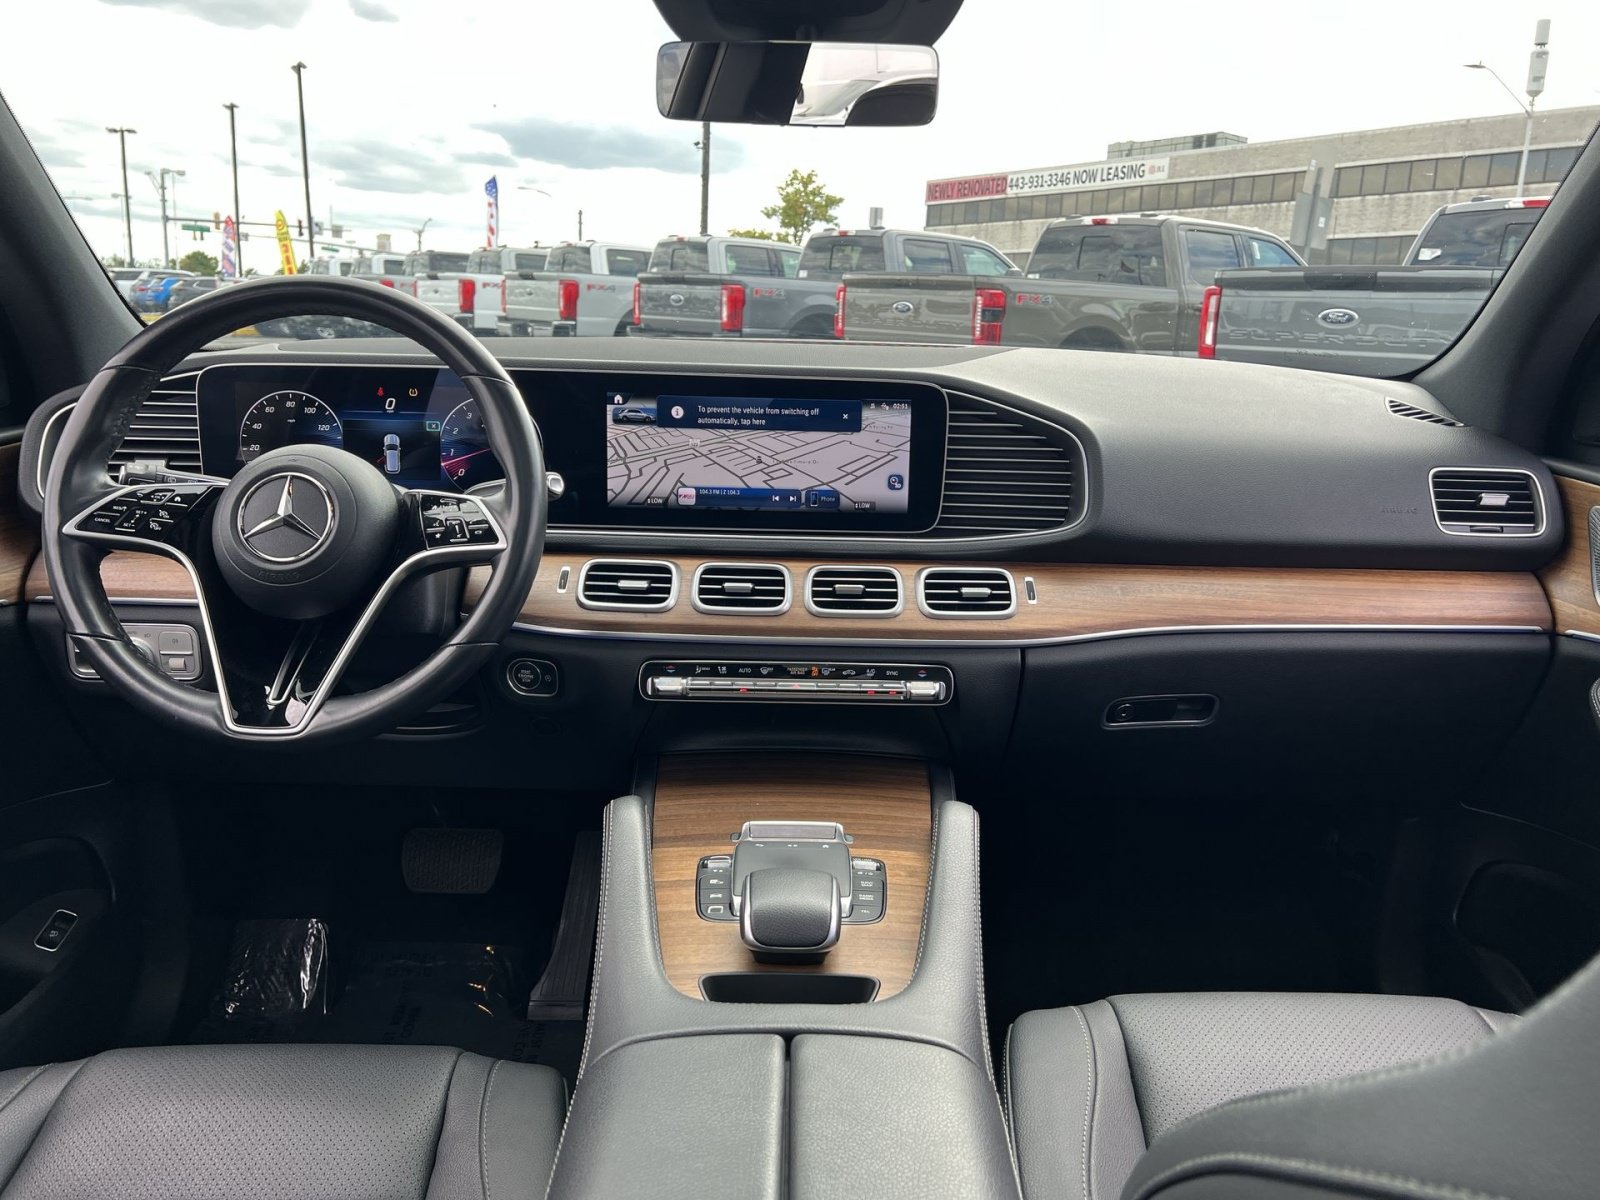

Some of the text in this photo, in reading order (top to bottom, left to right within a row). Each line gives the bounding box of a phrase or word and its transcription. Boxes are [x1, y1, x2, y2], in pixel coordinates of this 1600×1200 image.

[927, 163, 1146, 201] NEWLY RENOVATED 443-931-3346 NOW LEASING
[1016, 293, 1053, 305] FX4
[1228, 328, 1345, 345] SUPER
[385, 397, 396, 410] 0
[466, 412, 472, 420] 3
[698, 405, 819, 417] To prevent the vehicle from switching off
[697, 416, 766, 426] automatically, tap here
[452, 427, 459, 435] 2
[458, 468, 465, 477] 0
